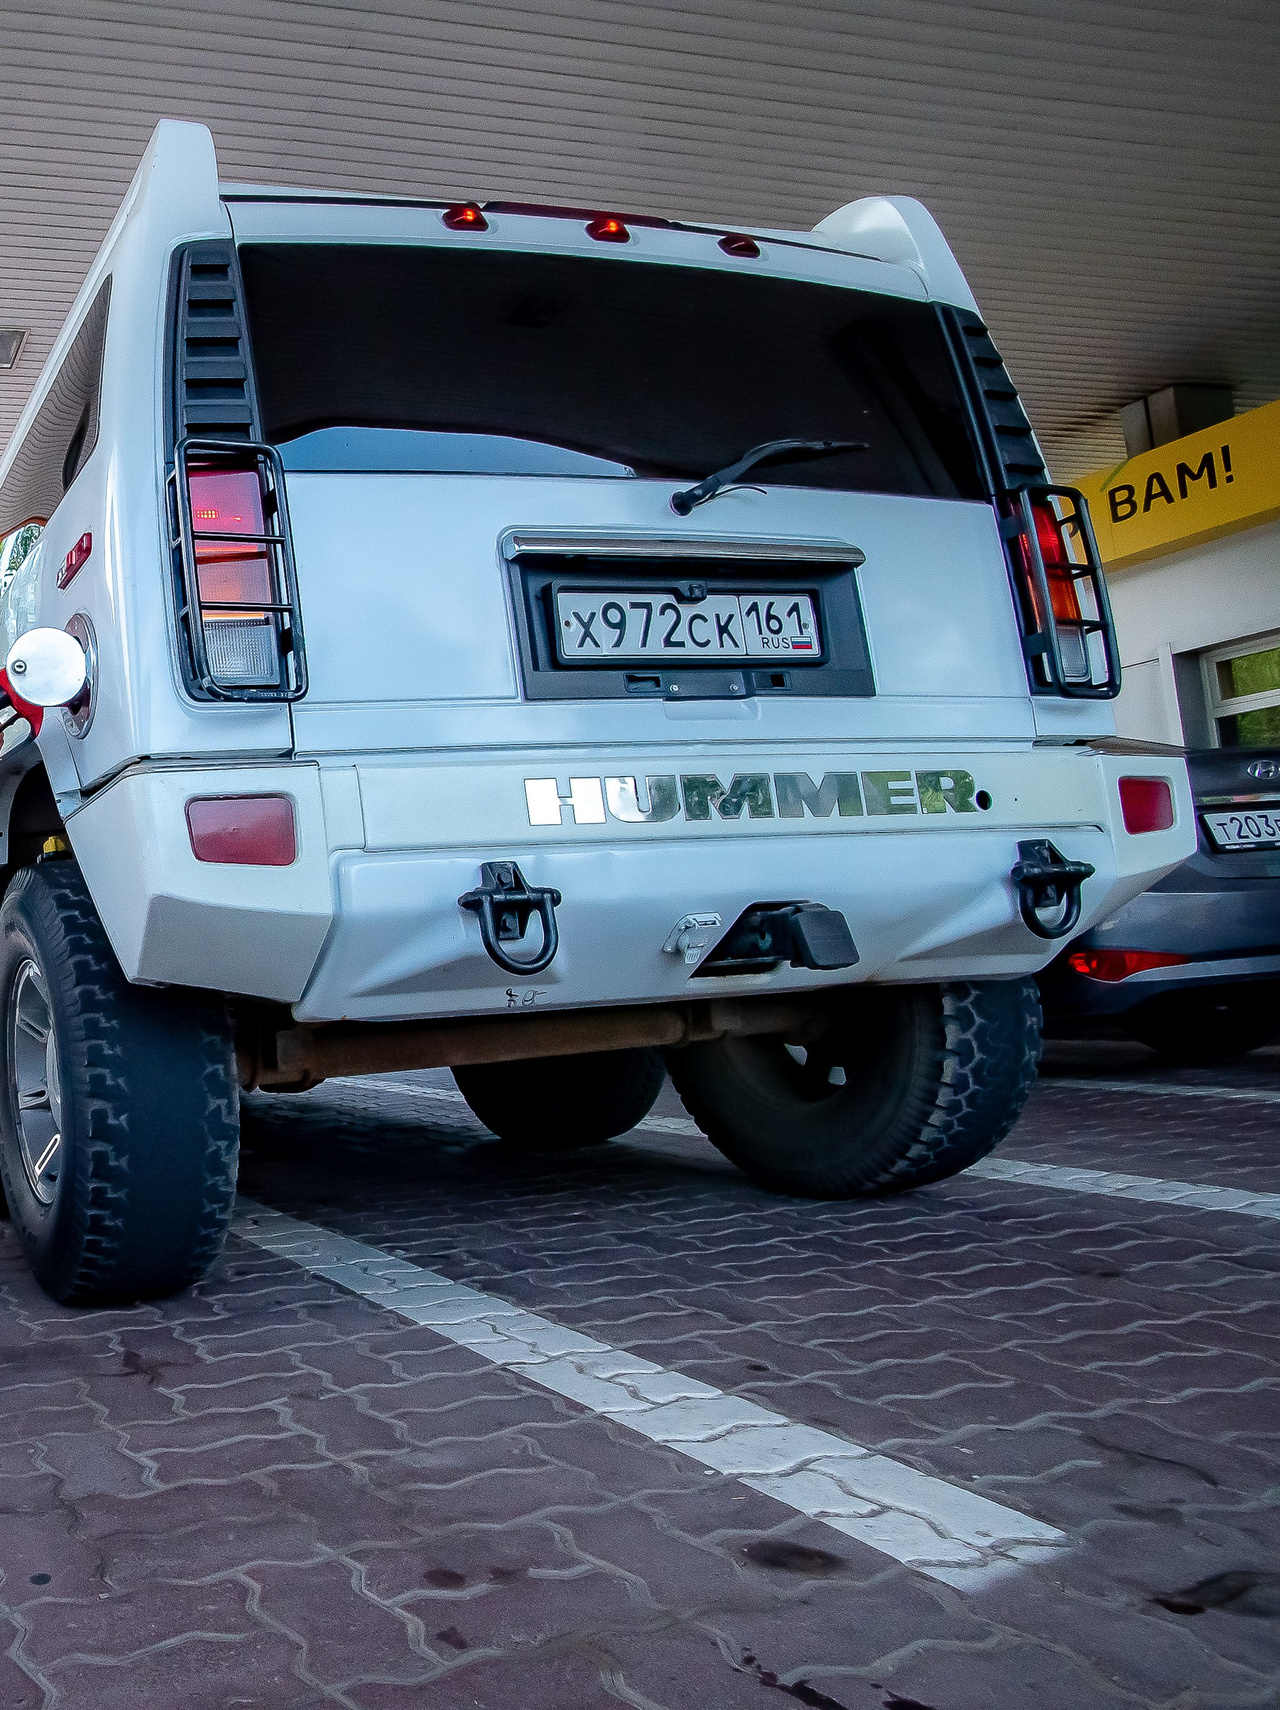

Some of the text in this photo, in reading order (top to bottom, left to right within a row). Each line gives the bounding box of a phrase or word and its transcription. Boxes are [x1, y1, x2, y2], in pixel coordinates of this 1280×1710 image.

[1108, 444, 1234, 524] ВАМ!
[744, 601, 803, 636] 161
[761, 636, 791, 650] RUS
[524, 769, 975, 826] HUMMER
